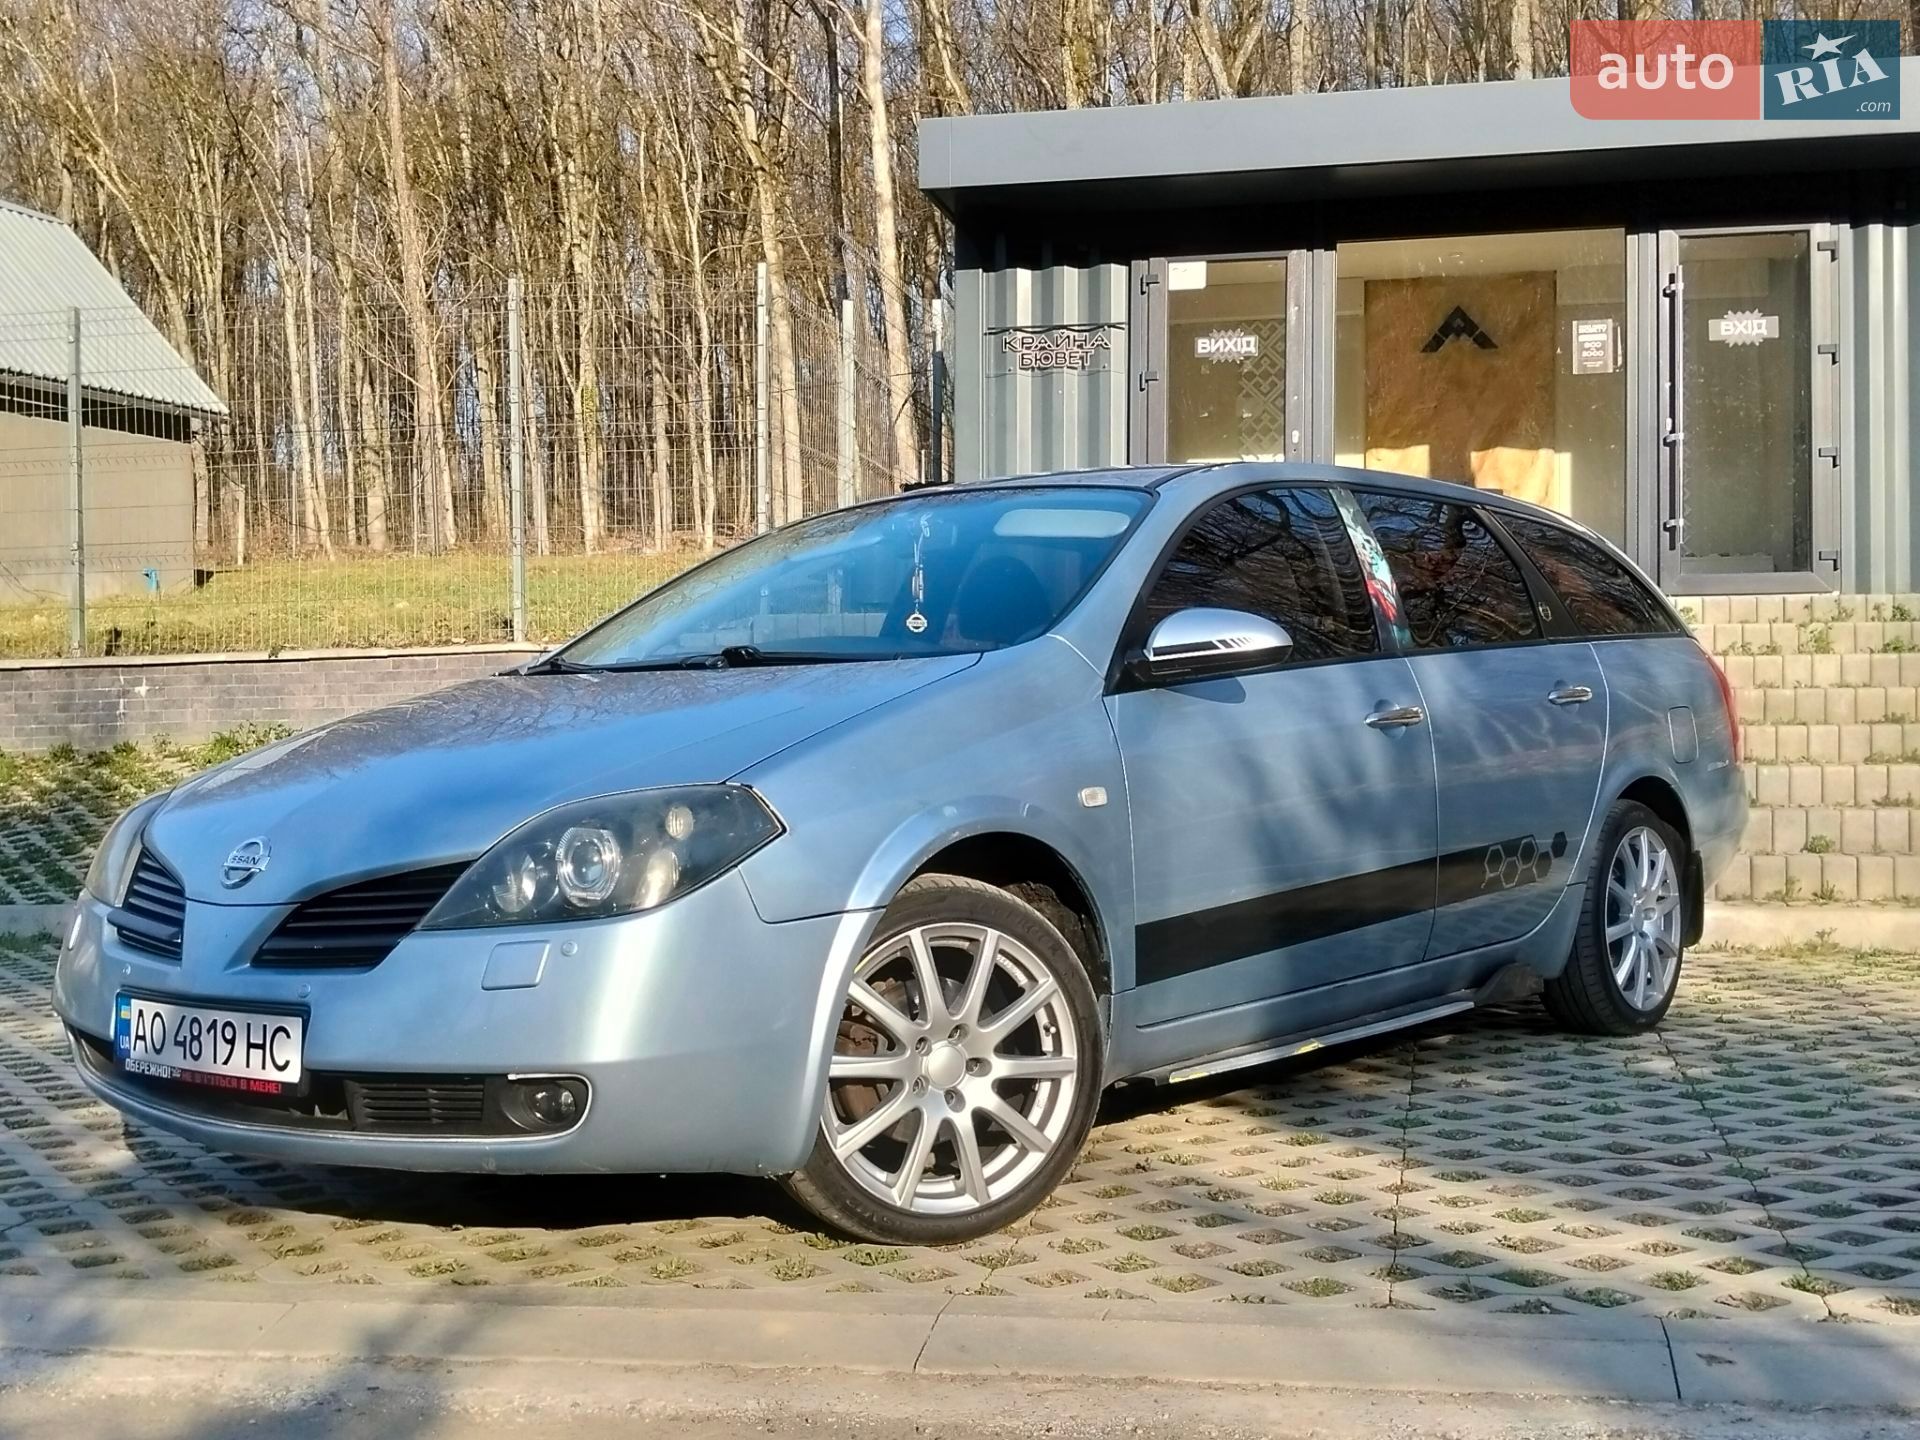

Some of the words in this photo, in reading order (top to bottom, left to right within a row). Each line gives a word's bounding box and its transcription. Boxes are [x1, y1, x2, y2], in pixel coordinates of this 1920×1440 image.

[1720, 318, 1768, 336] ВХІД
[1197, 334, 1256, 354] ВИХІД
[1019, 350, 1094, 369] БЮВЕТ
[120, 1035, 130, 1049] UA
[174, 1015, 237, 1066] 4819
[125, 1058, 171, 1079] ОБЕРЕЖНО!
[249, 1080, 282, 1094] МЕНЕ!
